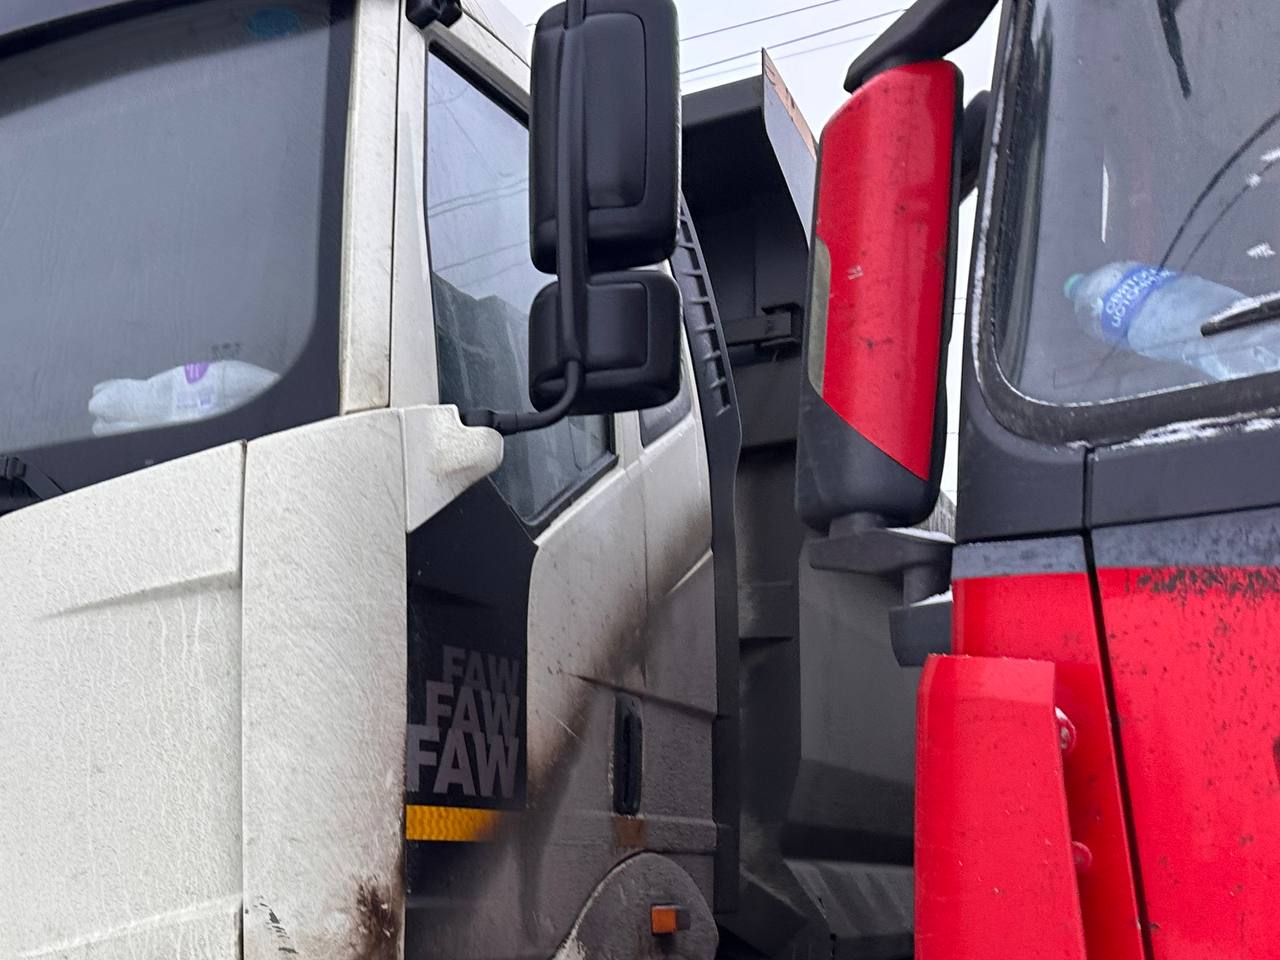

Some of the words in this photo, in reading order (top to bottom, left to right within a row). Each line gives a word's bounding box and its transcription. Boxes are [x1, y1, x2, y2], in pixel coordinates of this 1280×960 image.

[442, 645, 520, 696] FAW
[426, 680, 520, 740] FAW
[406, 723, 520, 799] FAW
